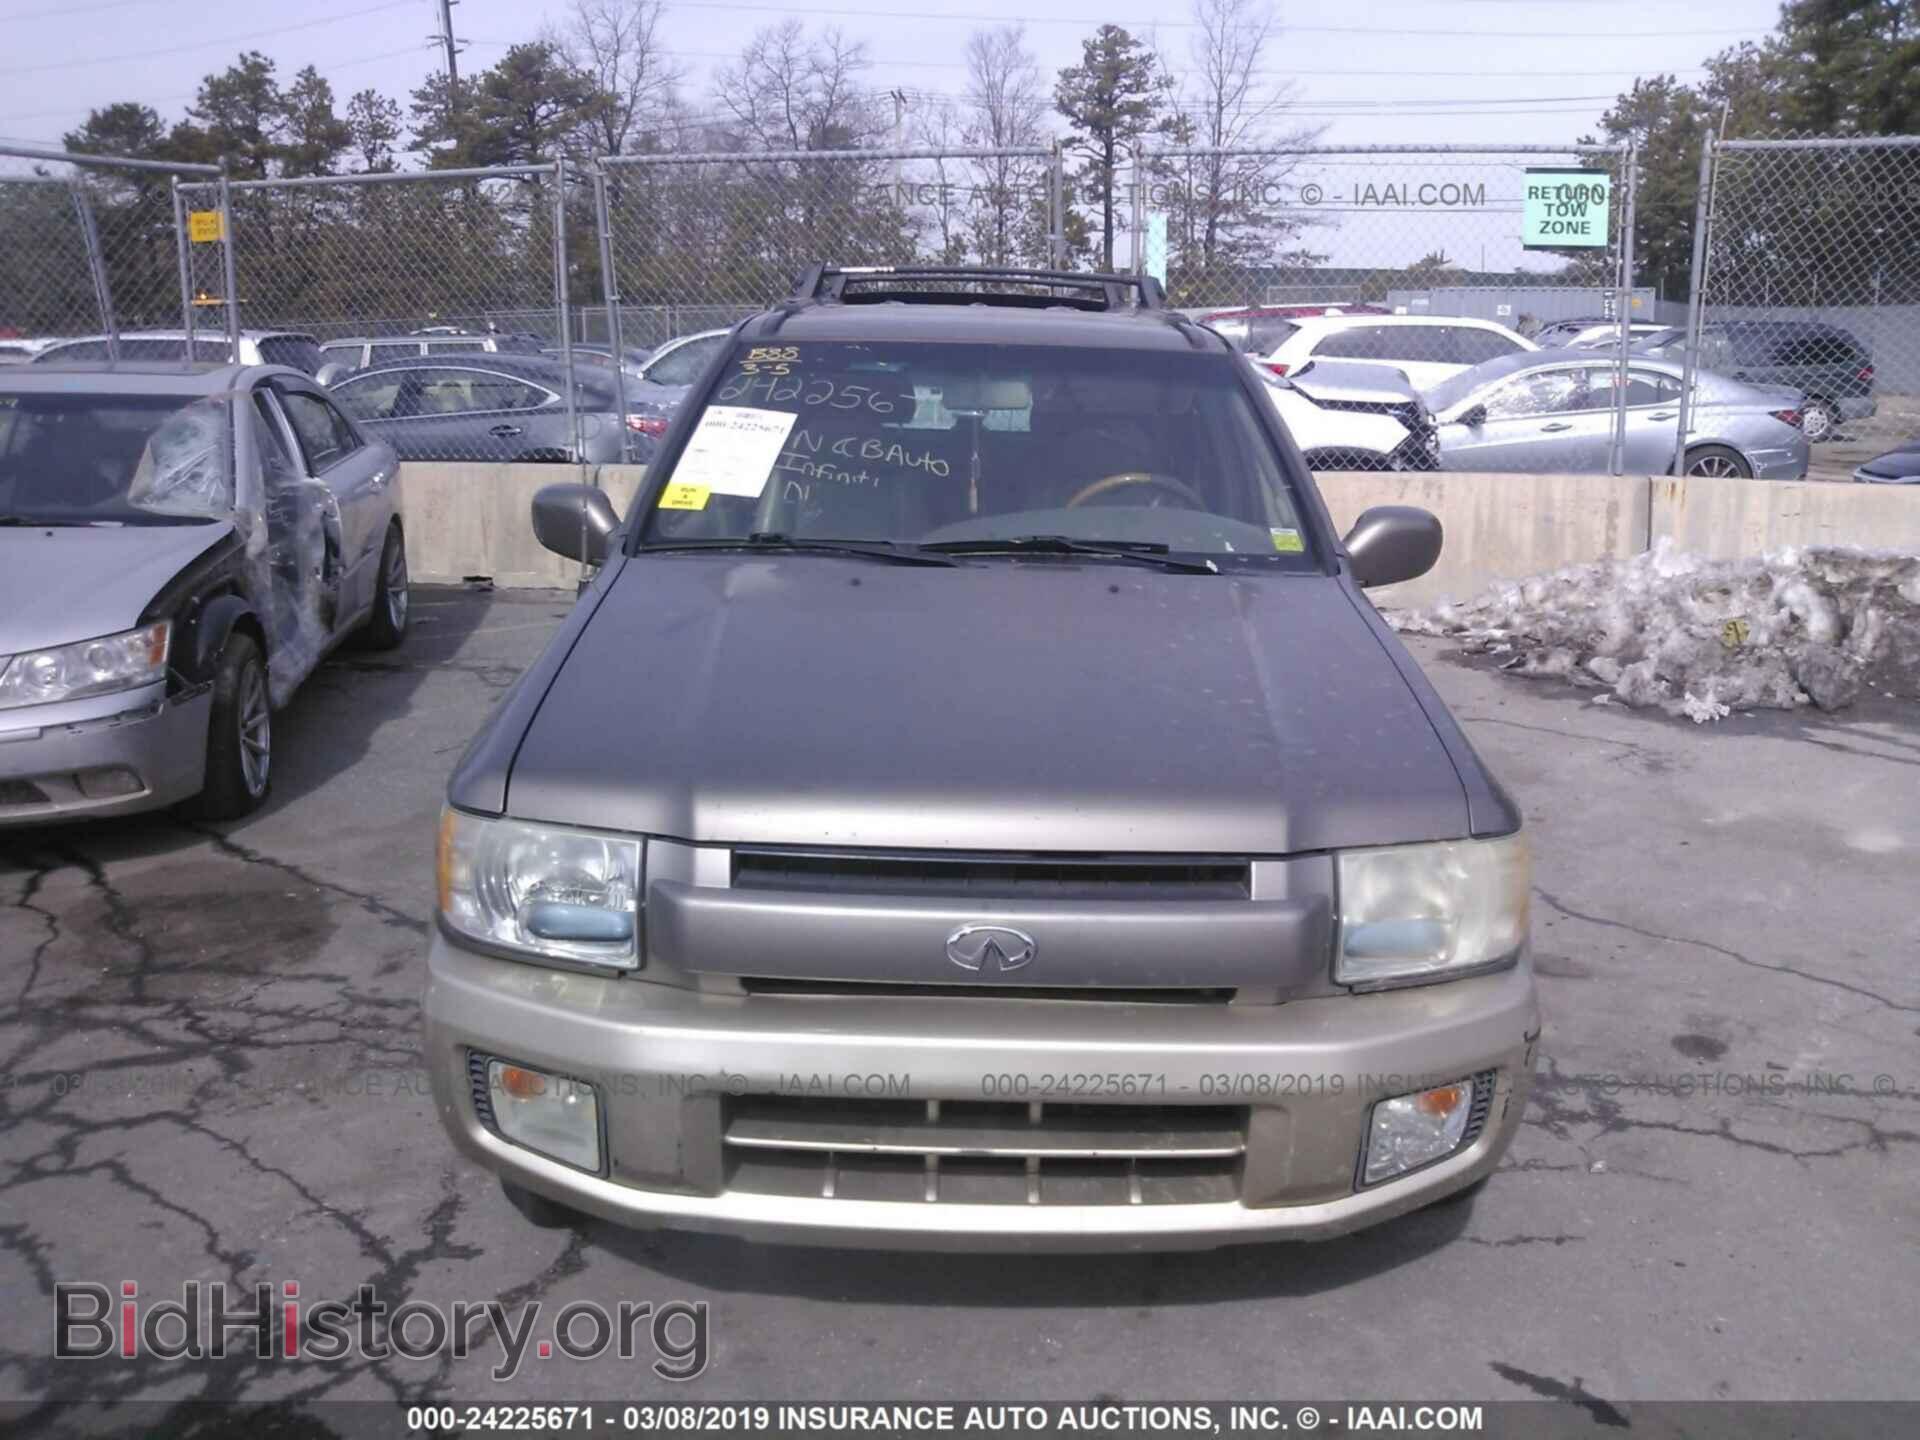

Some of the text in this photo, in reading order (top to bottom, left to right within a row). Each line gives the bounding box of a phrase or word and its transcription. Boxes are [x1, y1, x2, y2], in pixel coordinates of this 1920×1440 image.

[1528, 185, 1604, 200] RETURN
[1544, 203, 1588, 217] TOW
[1539, 221, 1591, 234] ZONE
